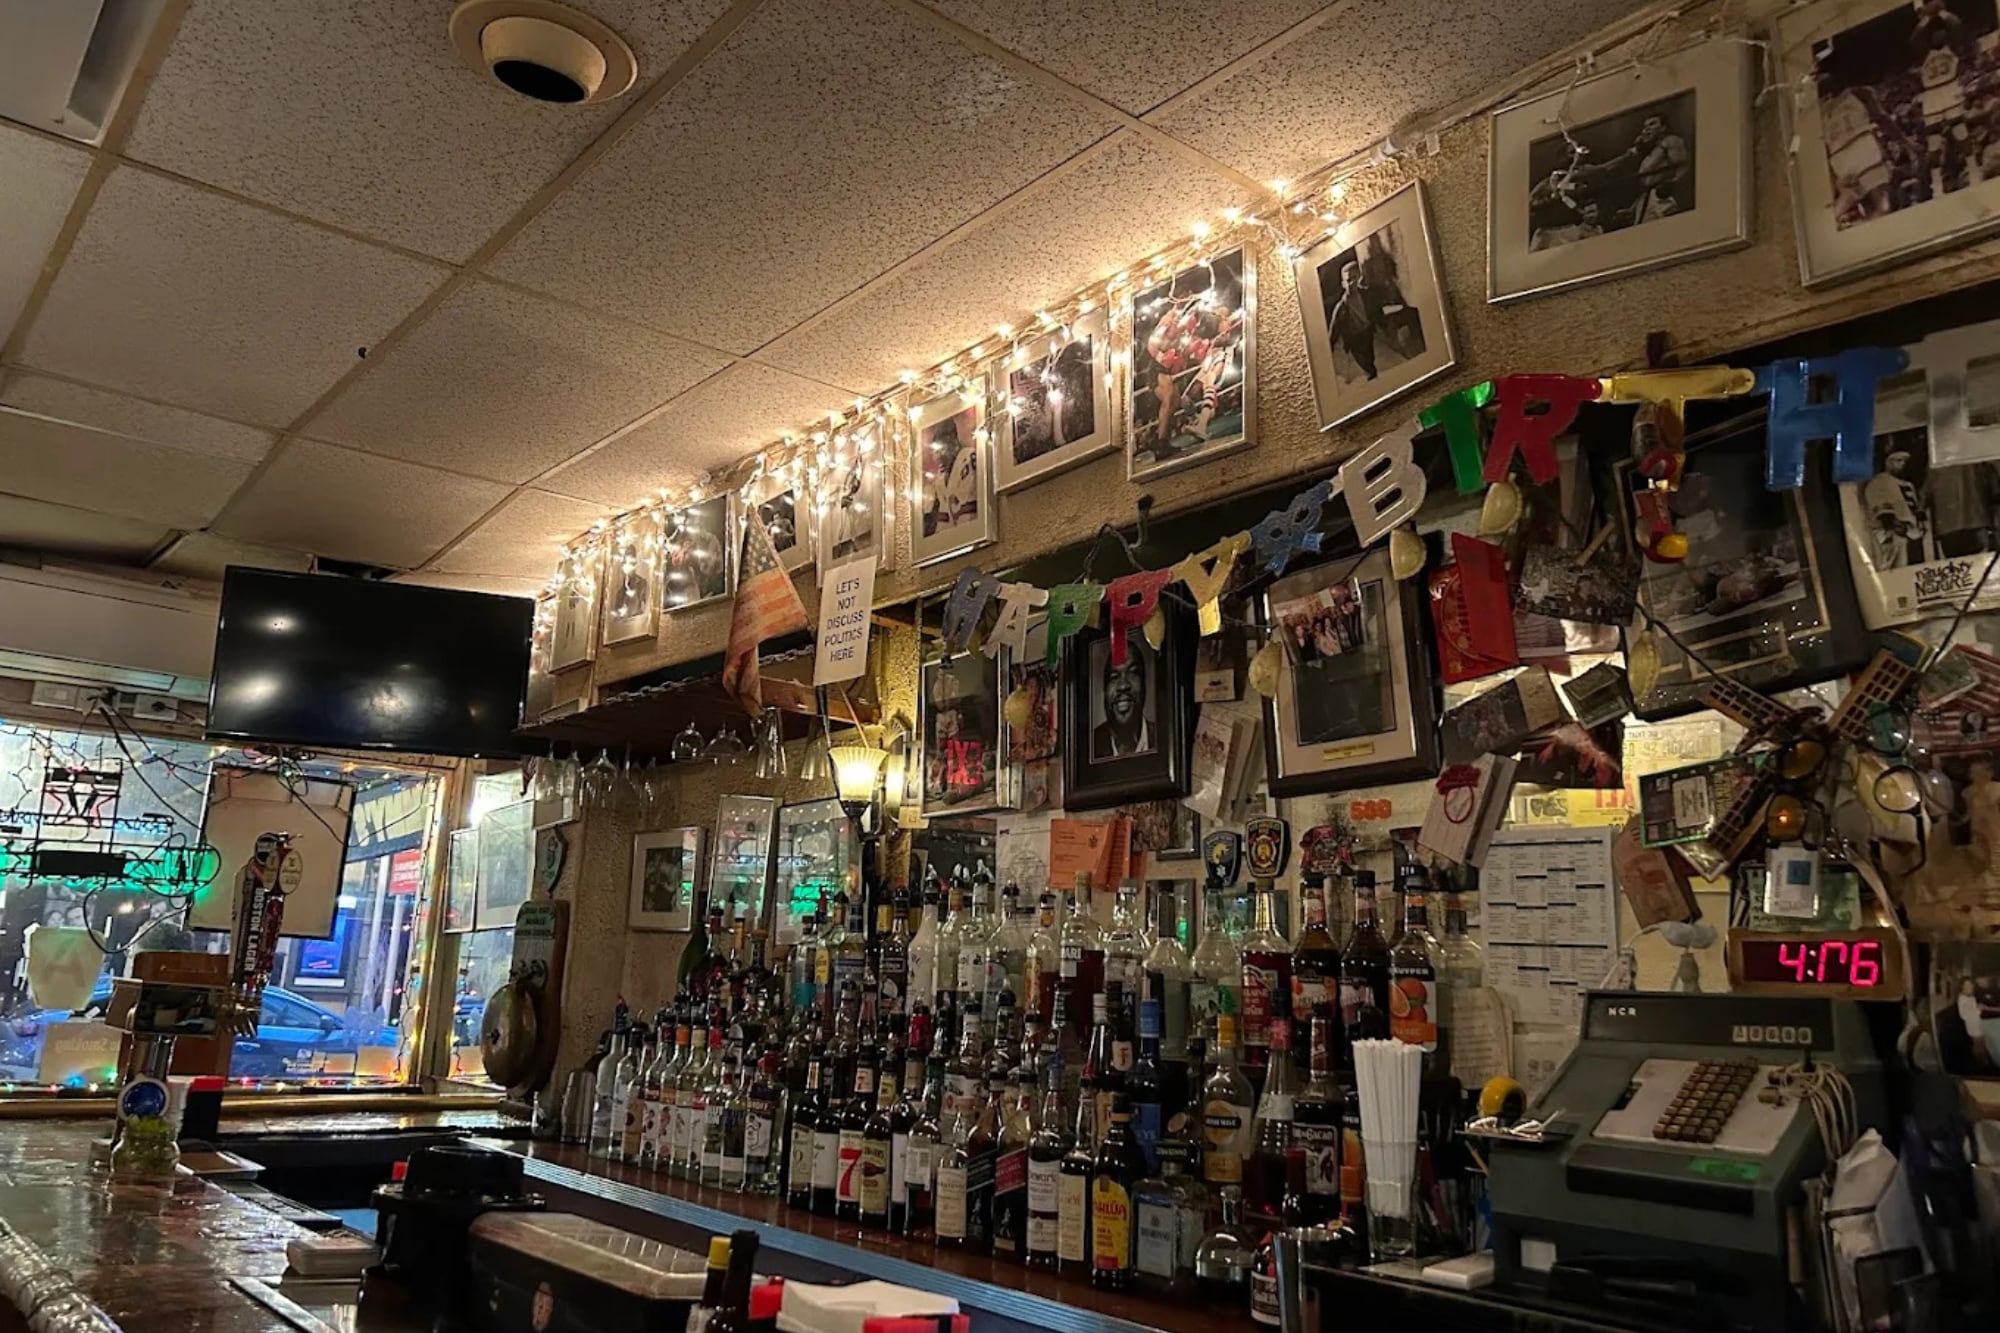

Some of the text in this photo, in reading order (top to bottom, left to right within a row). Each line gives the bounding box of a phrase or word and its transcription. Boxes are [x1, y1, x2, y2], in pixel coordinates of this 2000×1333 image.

[836, 578, 859, 595] LET'S
[837, 596, 856, 611] NOT
[942, 530, 1251, 669] HAPPY
[827, 610, 864, 630] DISCUSS
[824, 628, 862, 648] POLITICS
[830, 646, 854, 662] HERE
[244, 887, 266, 972] BOSTON LAGER
[1608, 1006, 1637, 1017] NCR
[838, 1148, 864, 1197] 7
